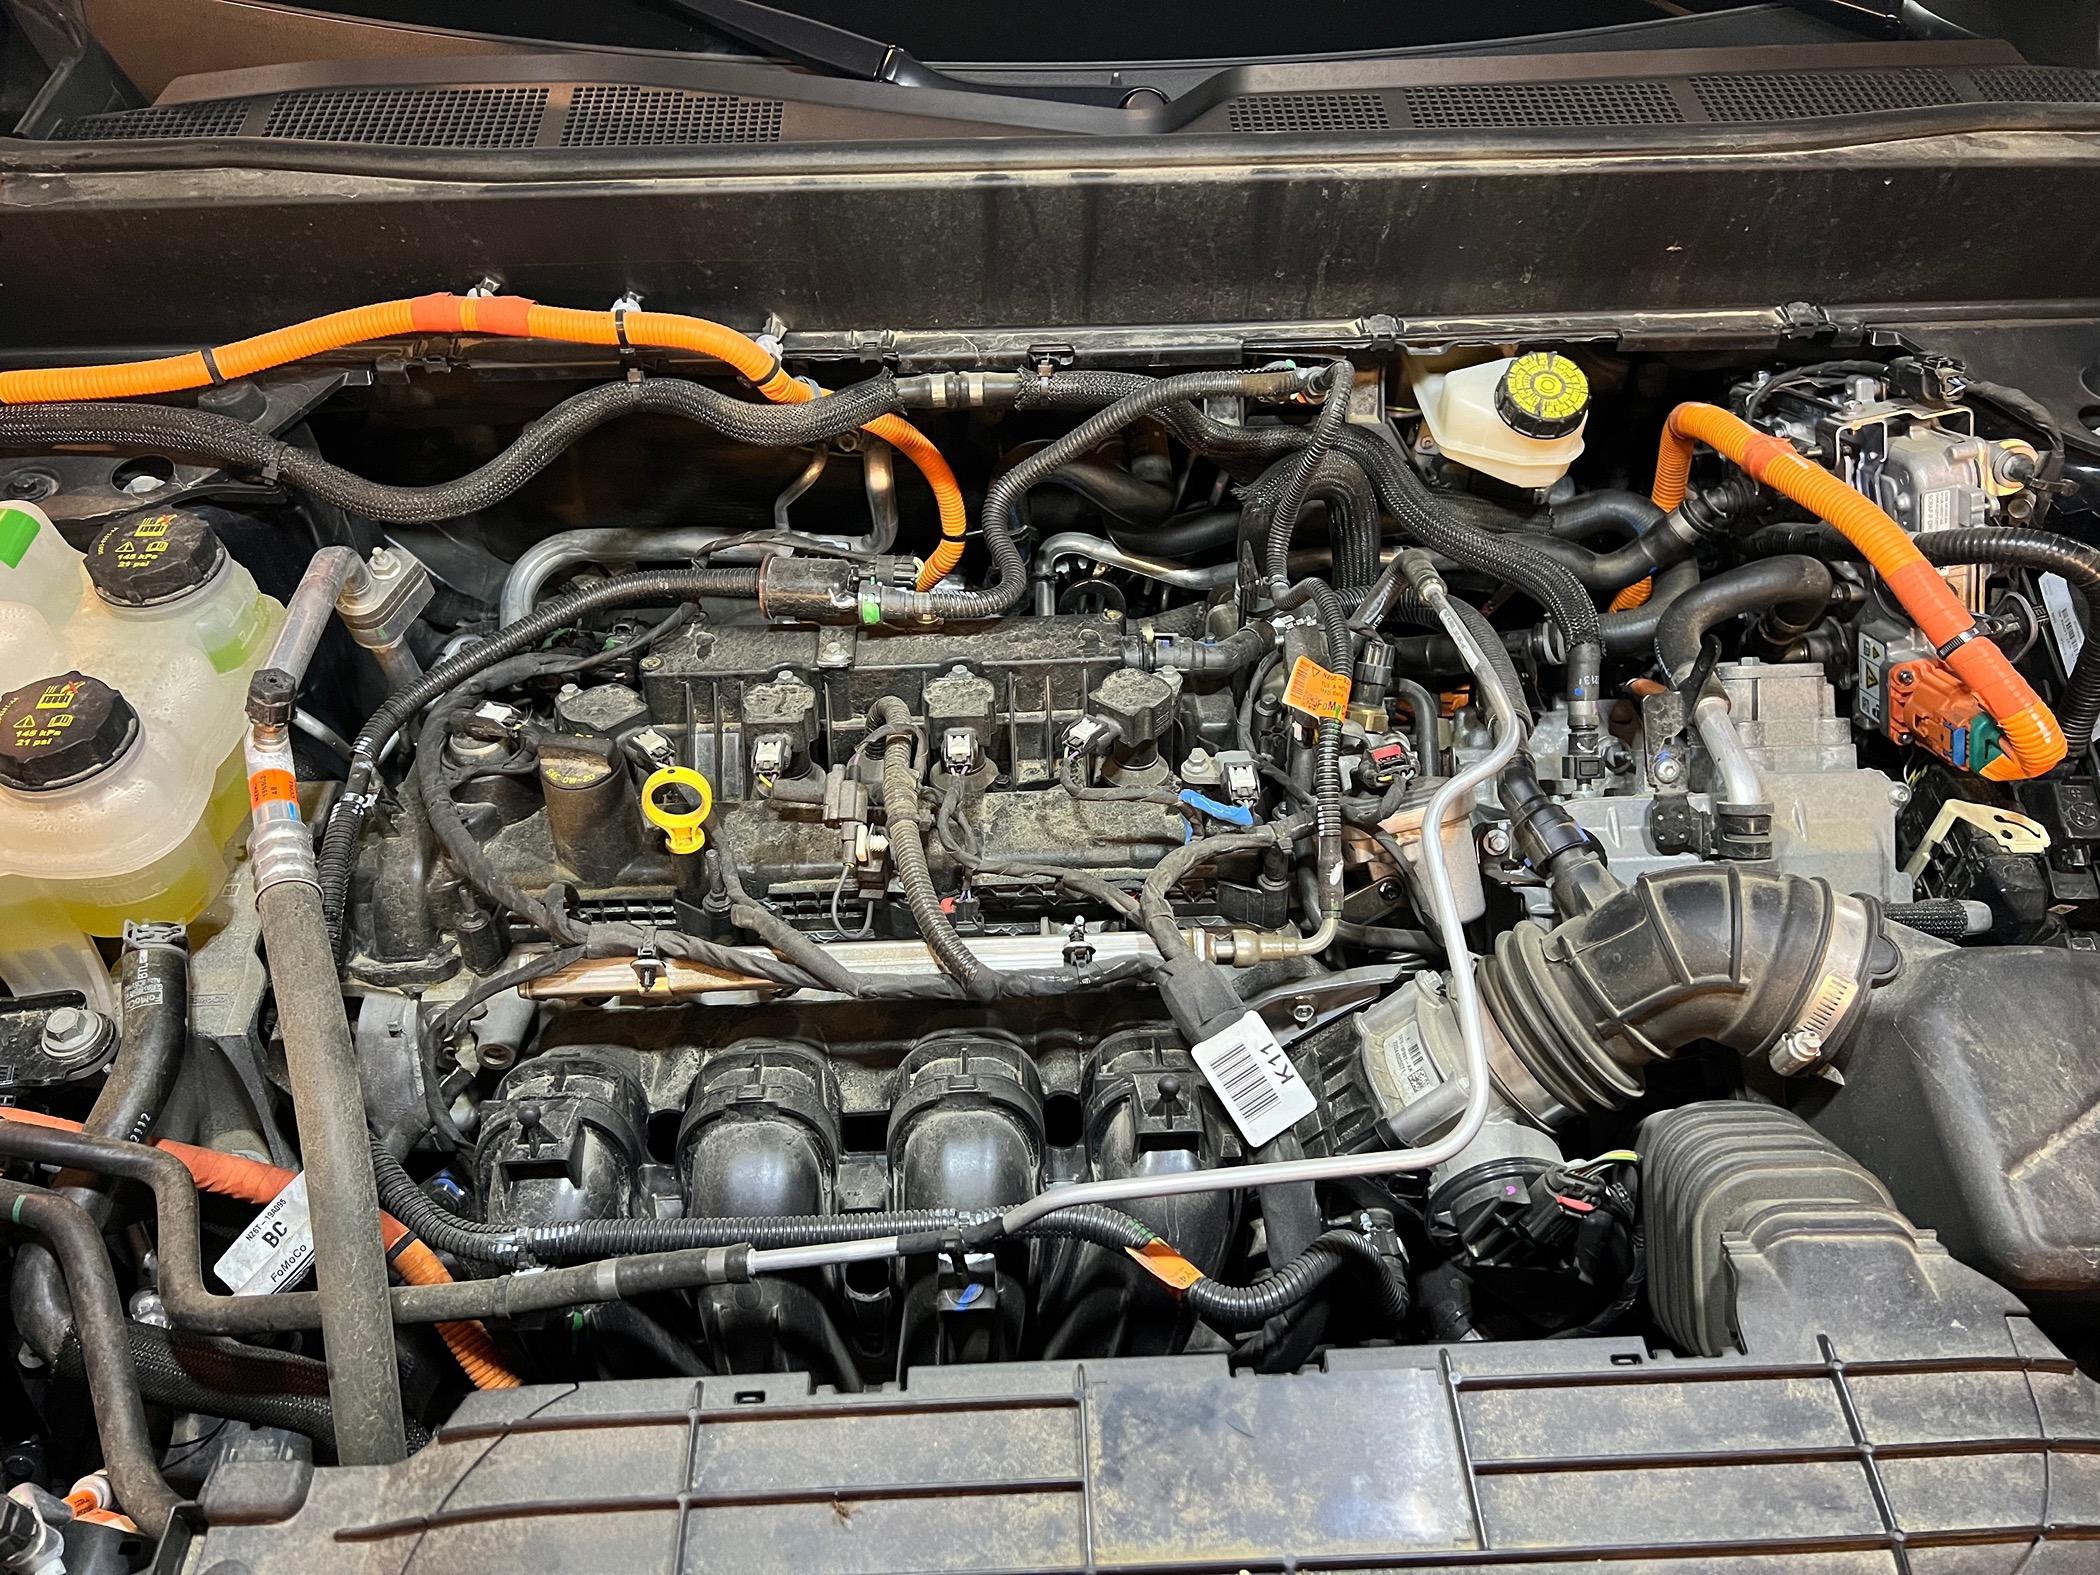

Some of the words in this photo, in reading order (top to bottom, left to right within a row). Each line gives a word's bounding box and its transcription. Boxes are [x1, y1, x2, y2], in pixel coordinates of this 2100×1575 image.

[132, 560, 151, 568] psi
[39, 729, 62, 738] kPa
[15, 738, 31, 747] 21
[32, 738, 53, 747] psi
[545, 768, 561, 781] SAE
[1260, 1042, 1295, 1085] K11
[262, 1221, 288, 1249] BC
[270, 1244, 307, 1283] FoMoCo
